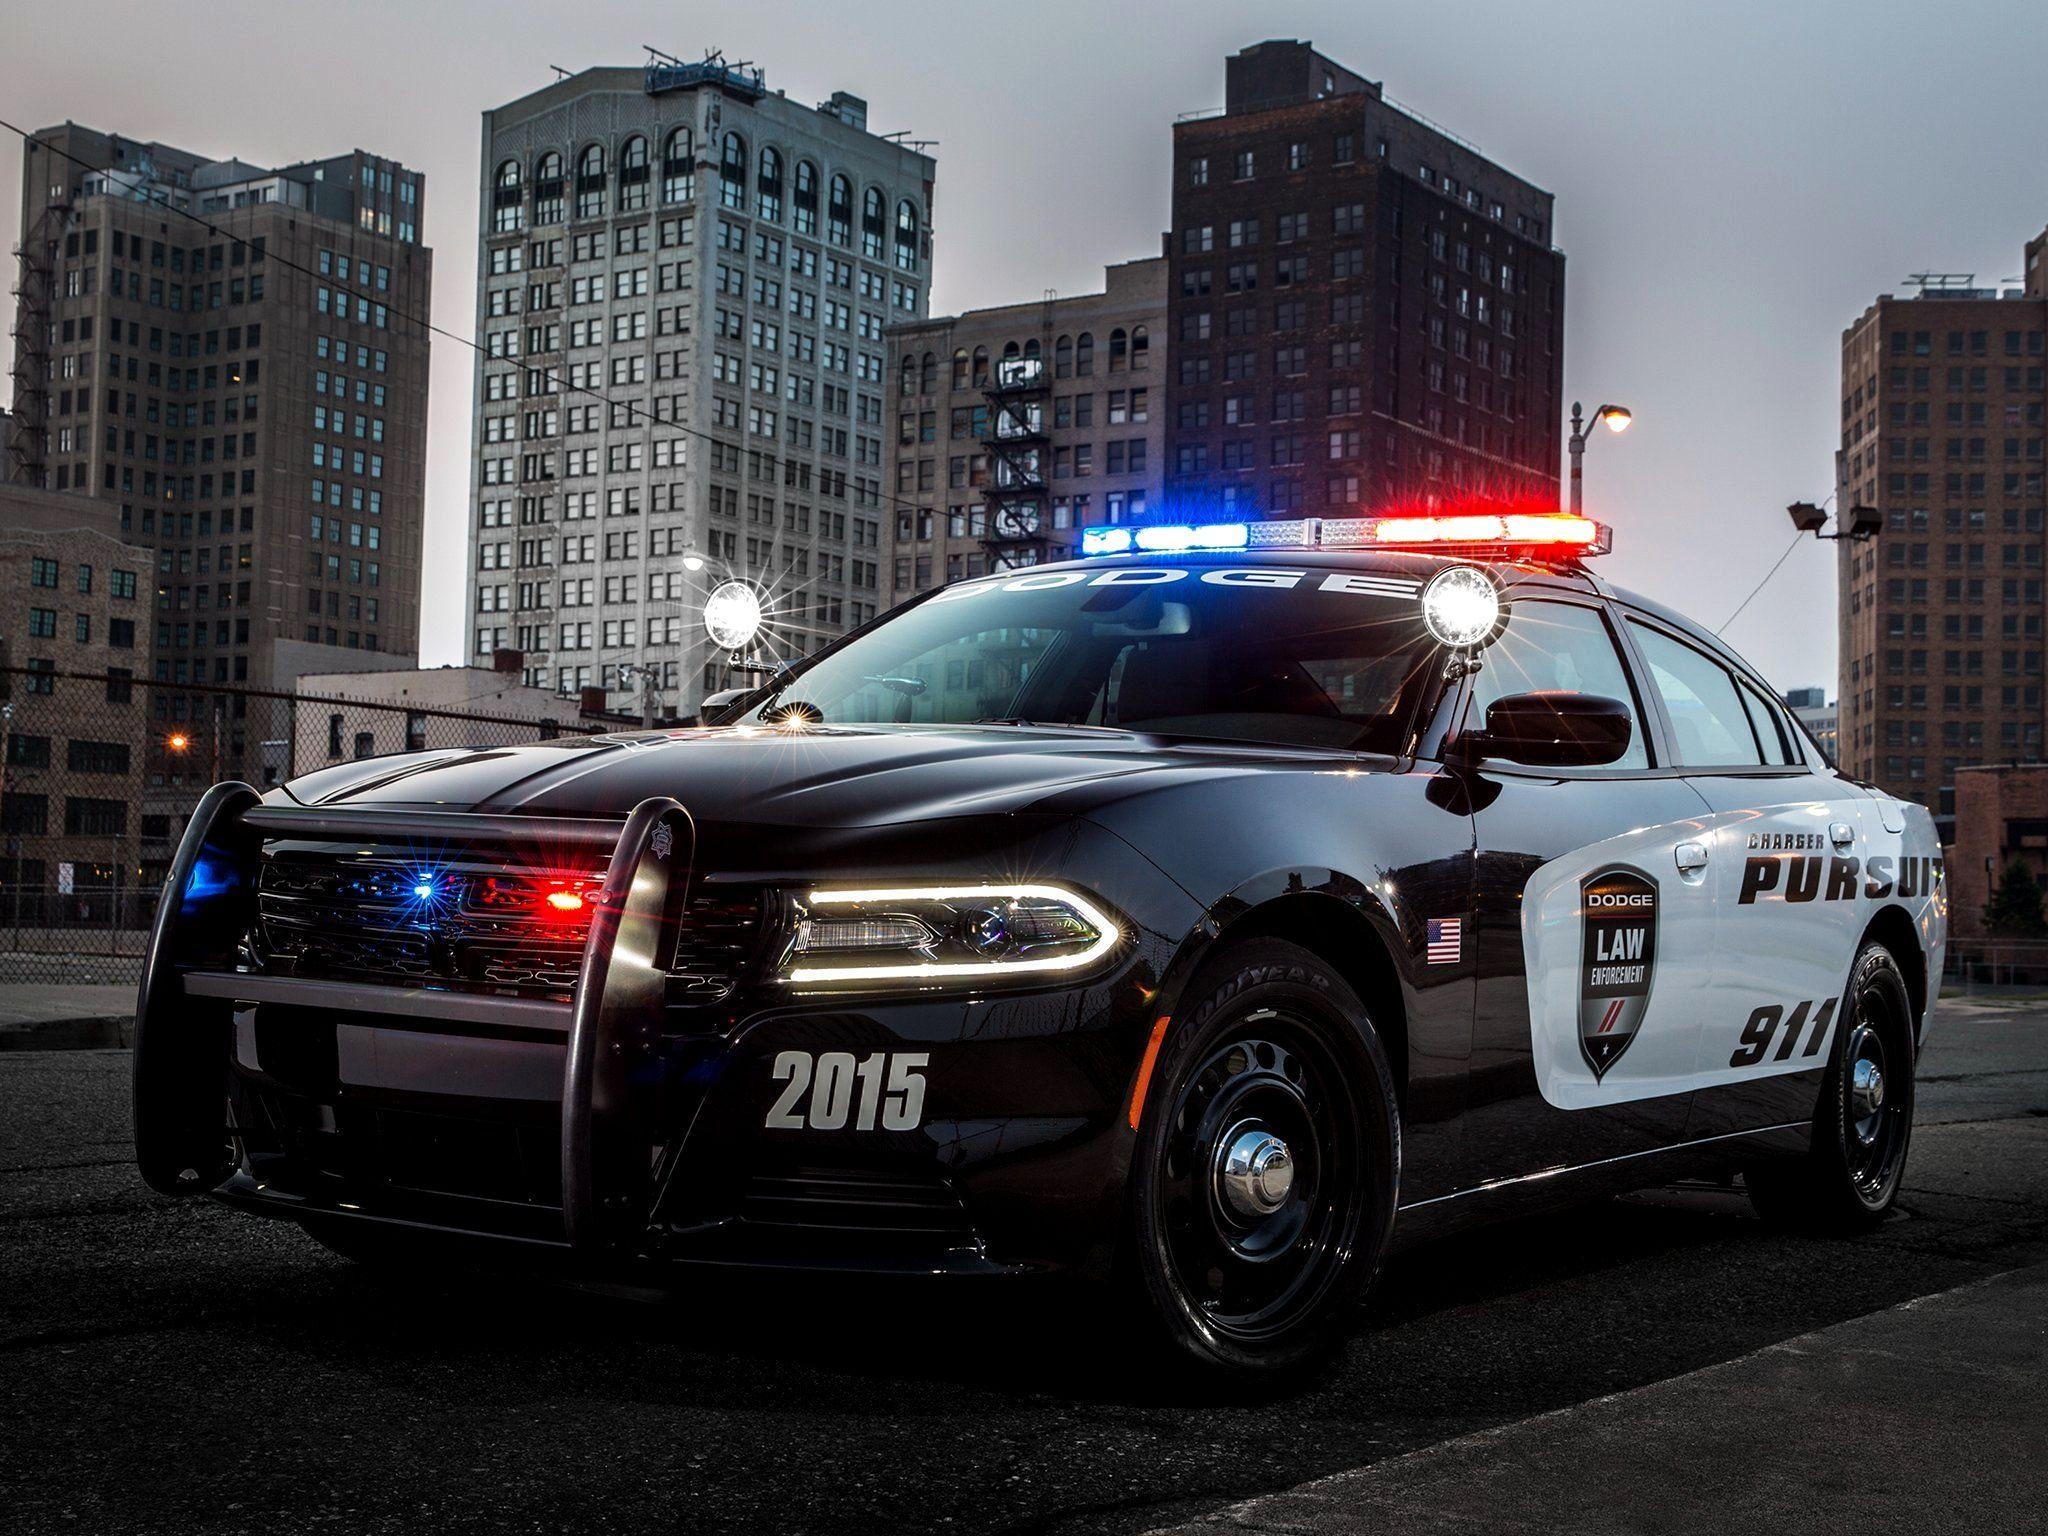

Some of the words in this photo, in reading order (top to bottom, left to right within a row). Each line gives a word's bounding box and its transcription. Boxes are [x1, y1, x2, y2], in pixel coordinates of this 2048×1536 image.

[921, 569, 1424, 606] DODGE
[1747, 833, 1824, 850] CHARGER
[1588, 894, 1653, 907] DODGE
[1596, 928, 1645, 962] LAW
[1590, 965, 1645, 986] ENFORCEMENT
[1729, 997, 1840, 1068] 911
[765, 1050, 930, 1131] 2015
